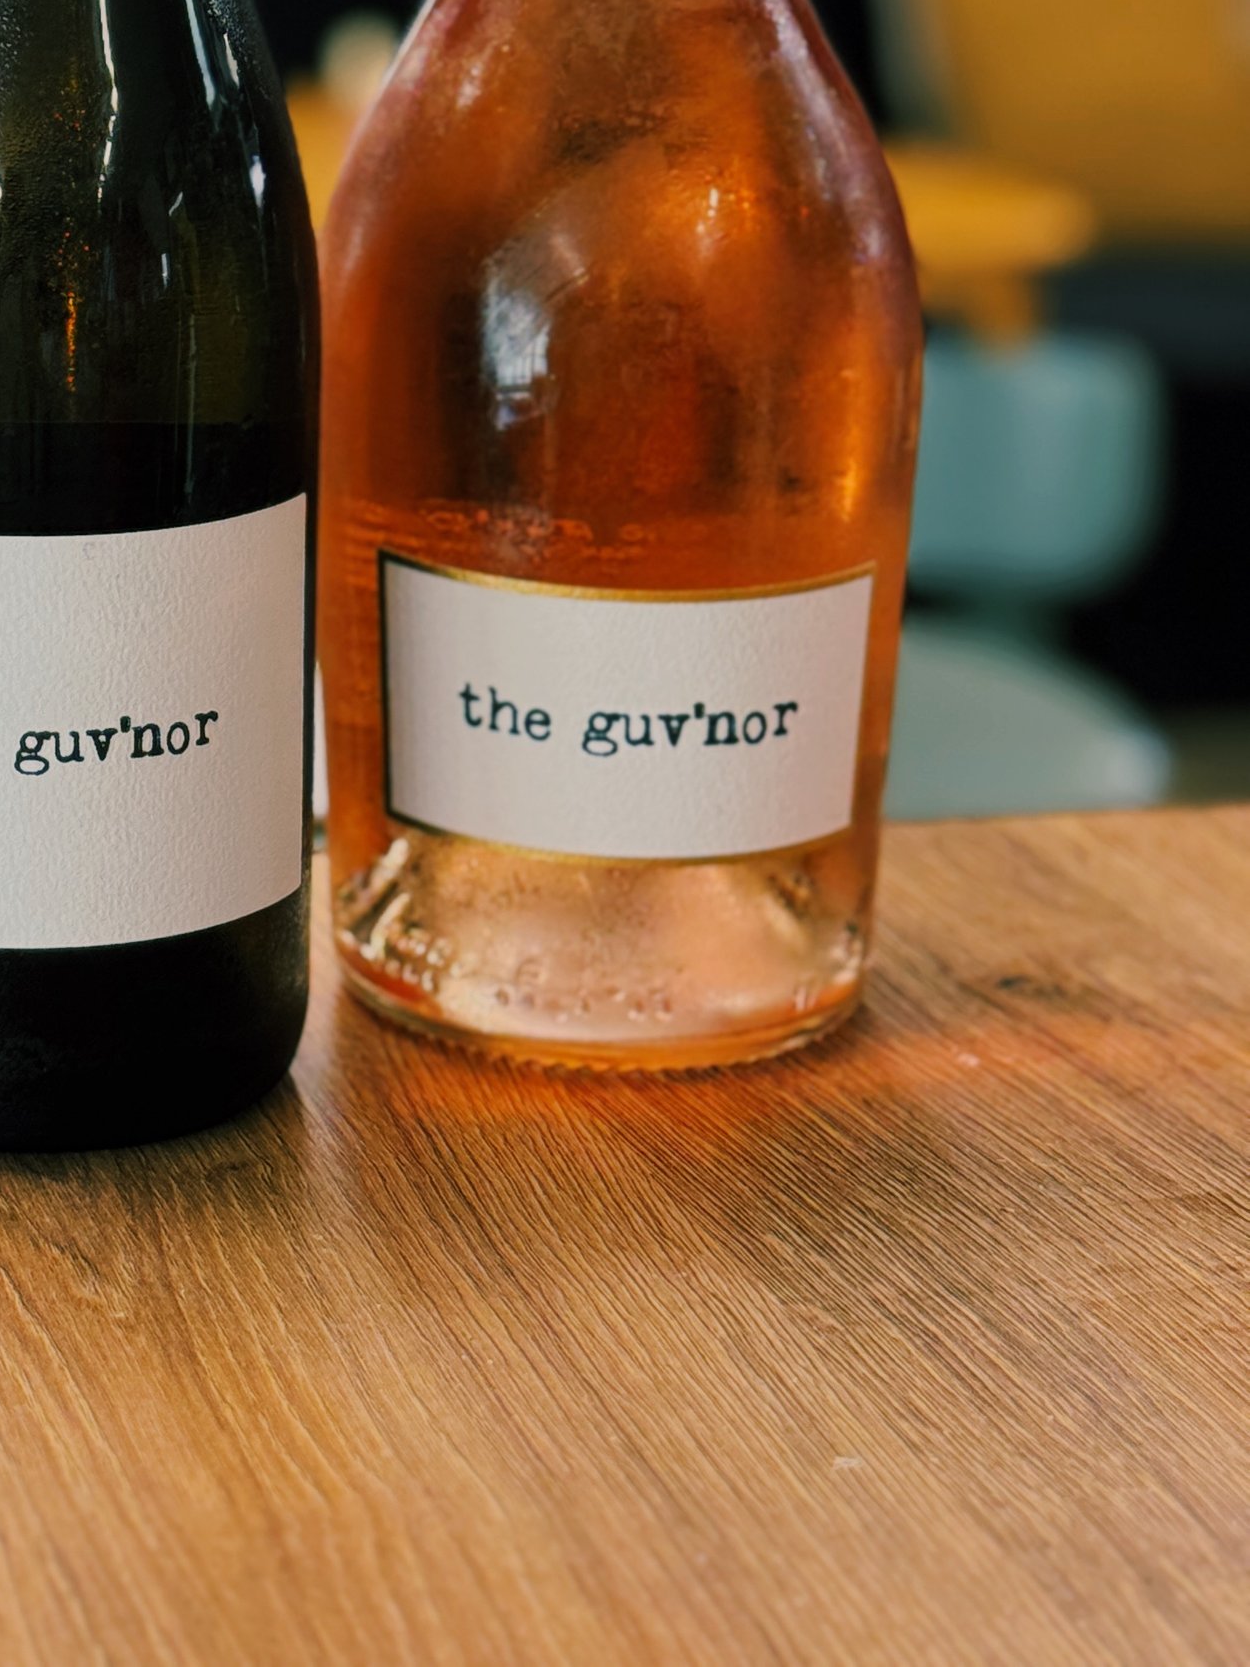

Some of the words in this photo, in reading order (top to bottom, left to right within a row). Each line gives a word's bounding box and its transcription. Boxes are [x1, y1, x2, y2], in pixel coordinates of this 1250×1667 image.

[14, 710, 219, 776] guv'nor
[459, 682, 551, 741] the
[581, 700, 799, 758] guv'nor
